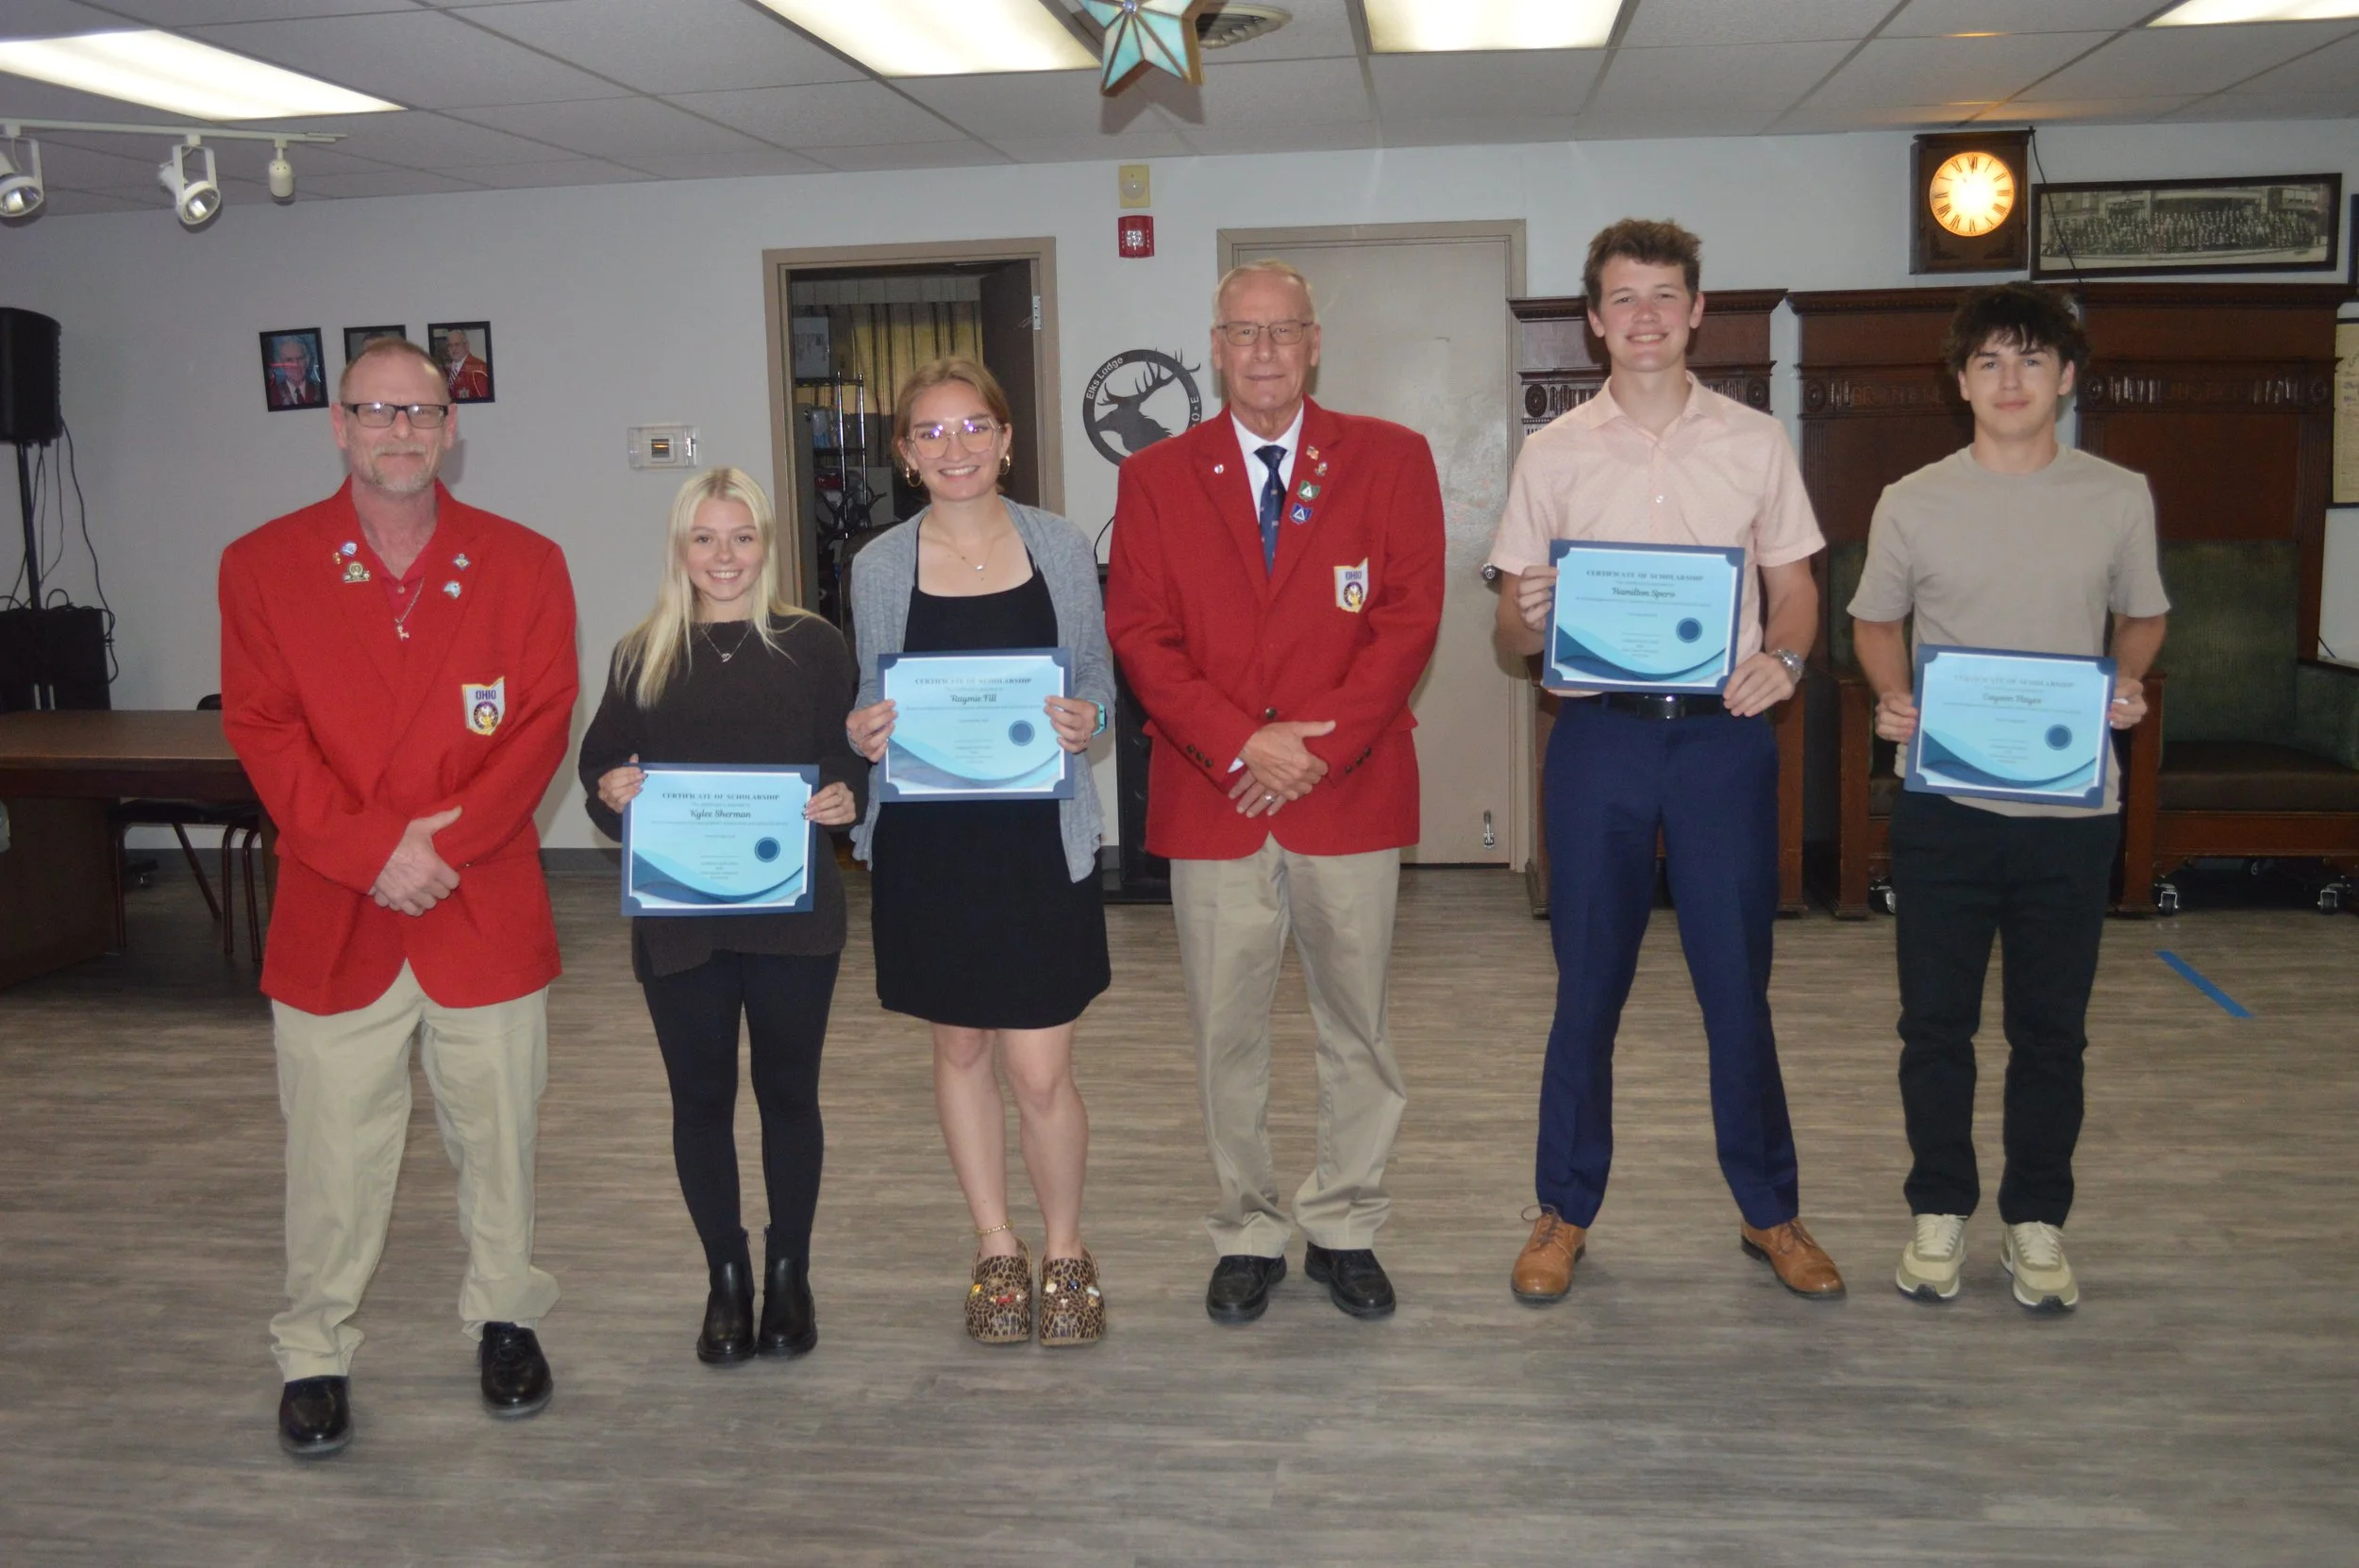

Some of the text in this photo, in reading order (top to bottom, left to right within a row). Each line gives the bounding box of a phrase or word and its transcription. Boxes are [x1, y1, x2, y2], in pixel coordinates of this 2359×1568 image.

[1086, 357, 1124, 399] Elks Lodge
[1650, 573, 1703, 581] SCHOLARSHIP
[1612, 588, 1649, 596] Hamilton
[476, 690, 496, 700] OHIO
[691, 809, 751, 820] Kylee Sherman
